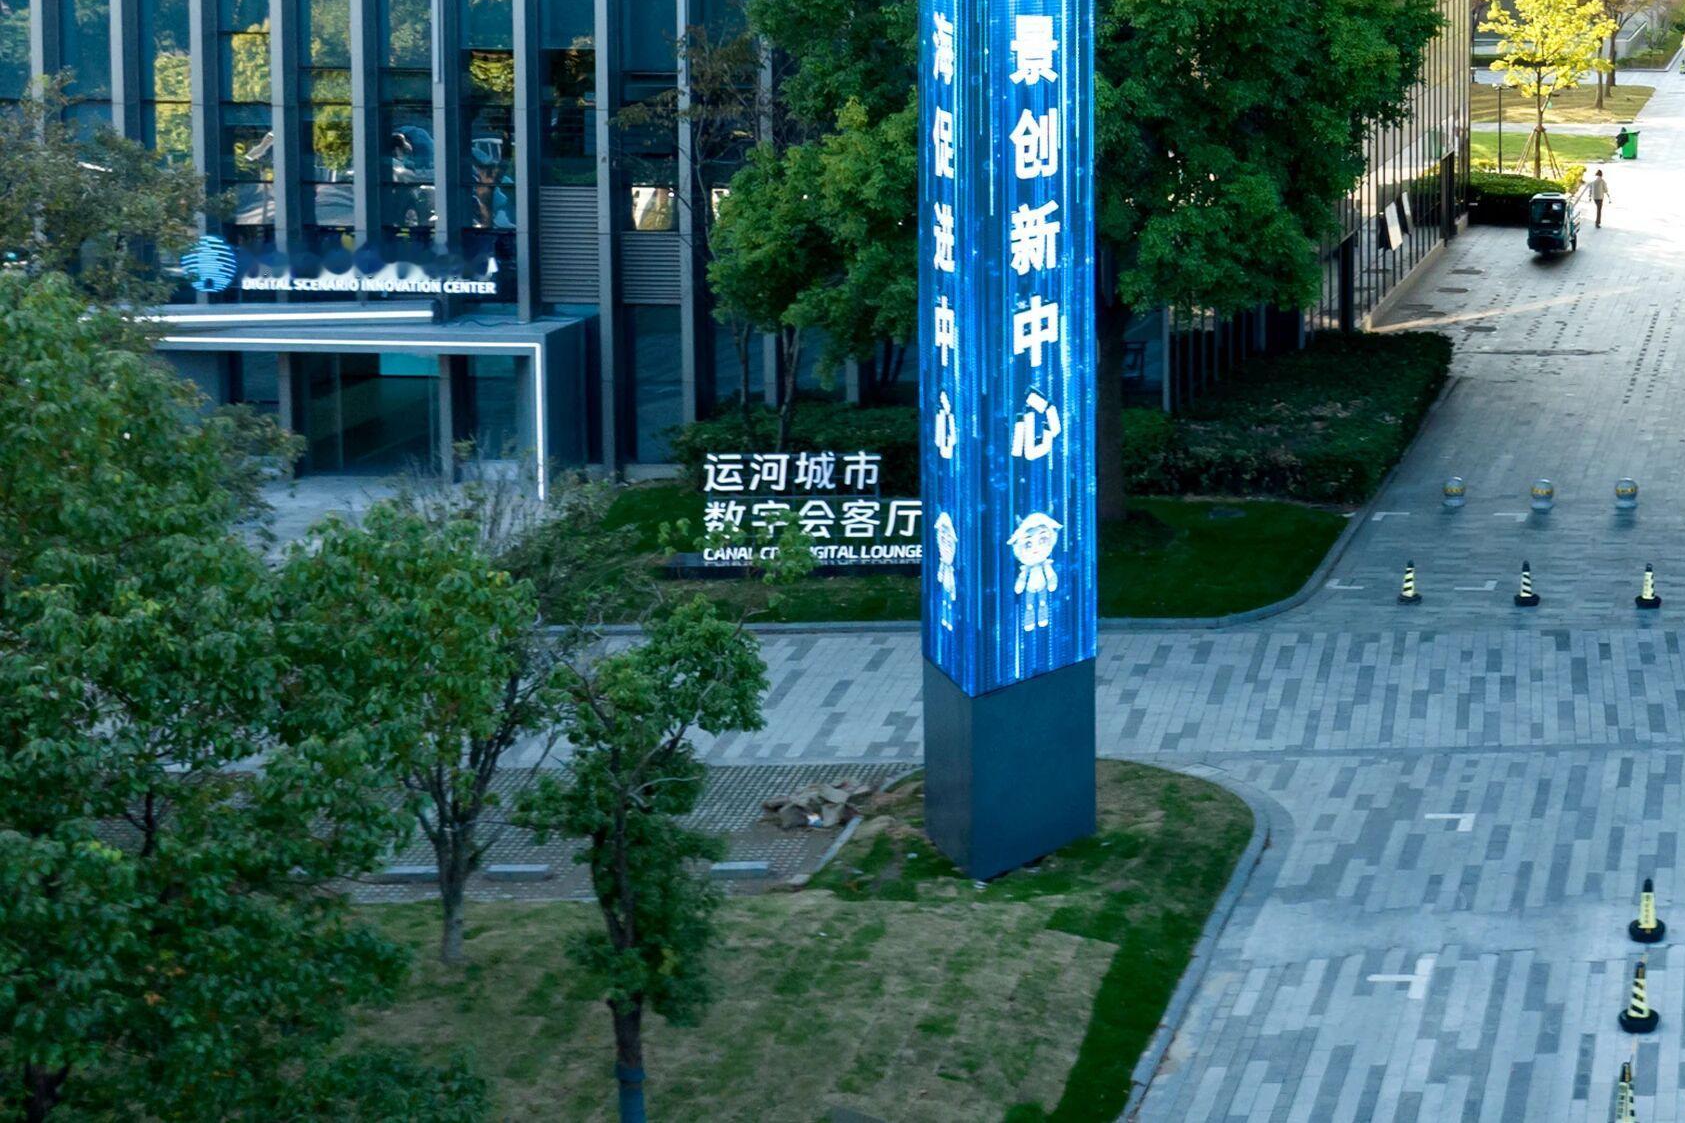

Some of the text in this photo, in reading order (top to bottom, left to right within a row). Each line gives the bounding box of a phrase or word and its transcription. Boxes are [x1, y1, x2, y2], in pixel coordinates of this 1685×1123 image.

[242, 278, 292, 290] DIGITAL
[293, 278, 359, 292] SCENARIO
[443, 281, 497, 294] CENTER
[703, 450, 882, 492] 运河城市
[703, 500, 923, 539] 数字会客厅
[810, 545, 859, 559] GITAL
[860, 544, 923, 559] LOUNGE
